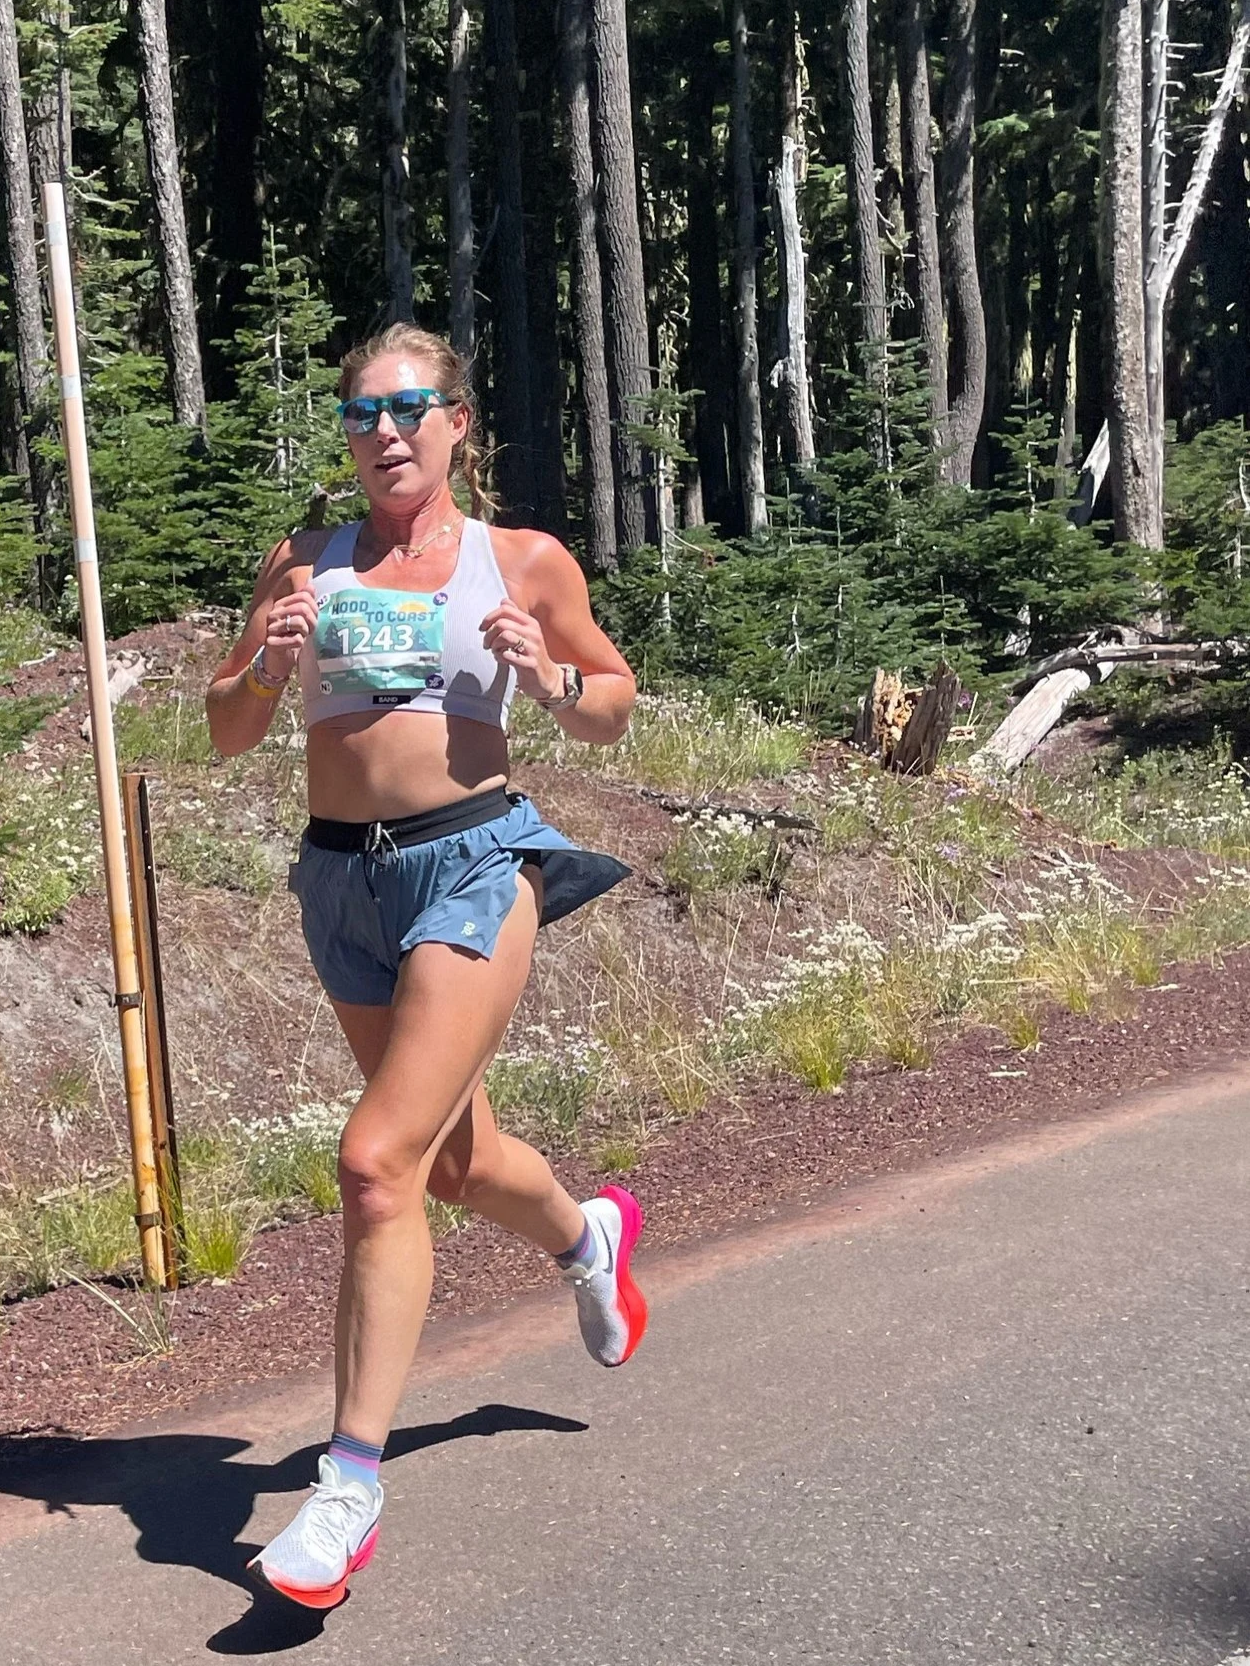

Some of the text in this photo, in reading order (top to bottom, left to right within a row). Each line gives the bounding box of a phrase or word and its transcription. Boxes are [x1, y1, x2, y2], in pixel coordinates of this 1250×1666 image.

[332, 600, 369, 615] HOOD
[365, 611, 438, 623] TO COAST
[337, 624, 414, 655] 1243
